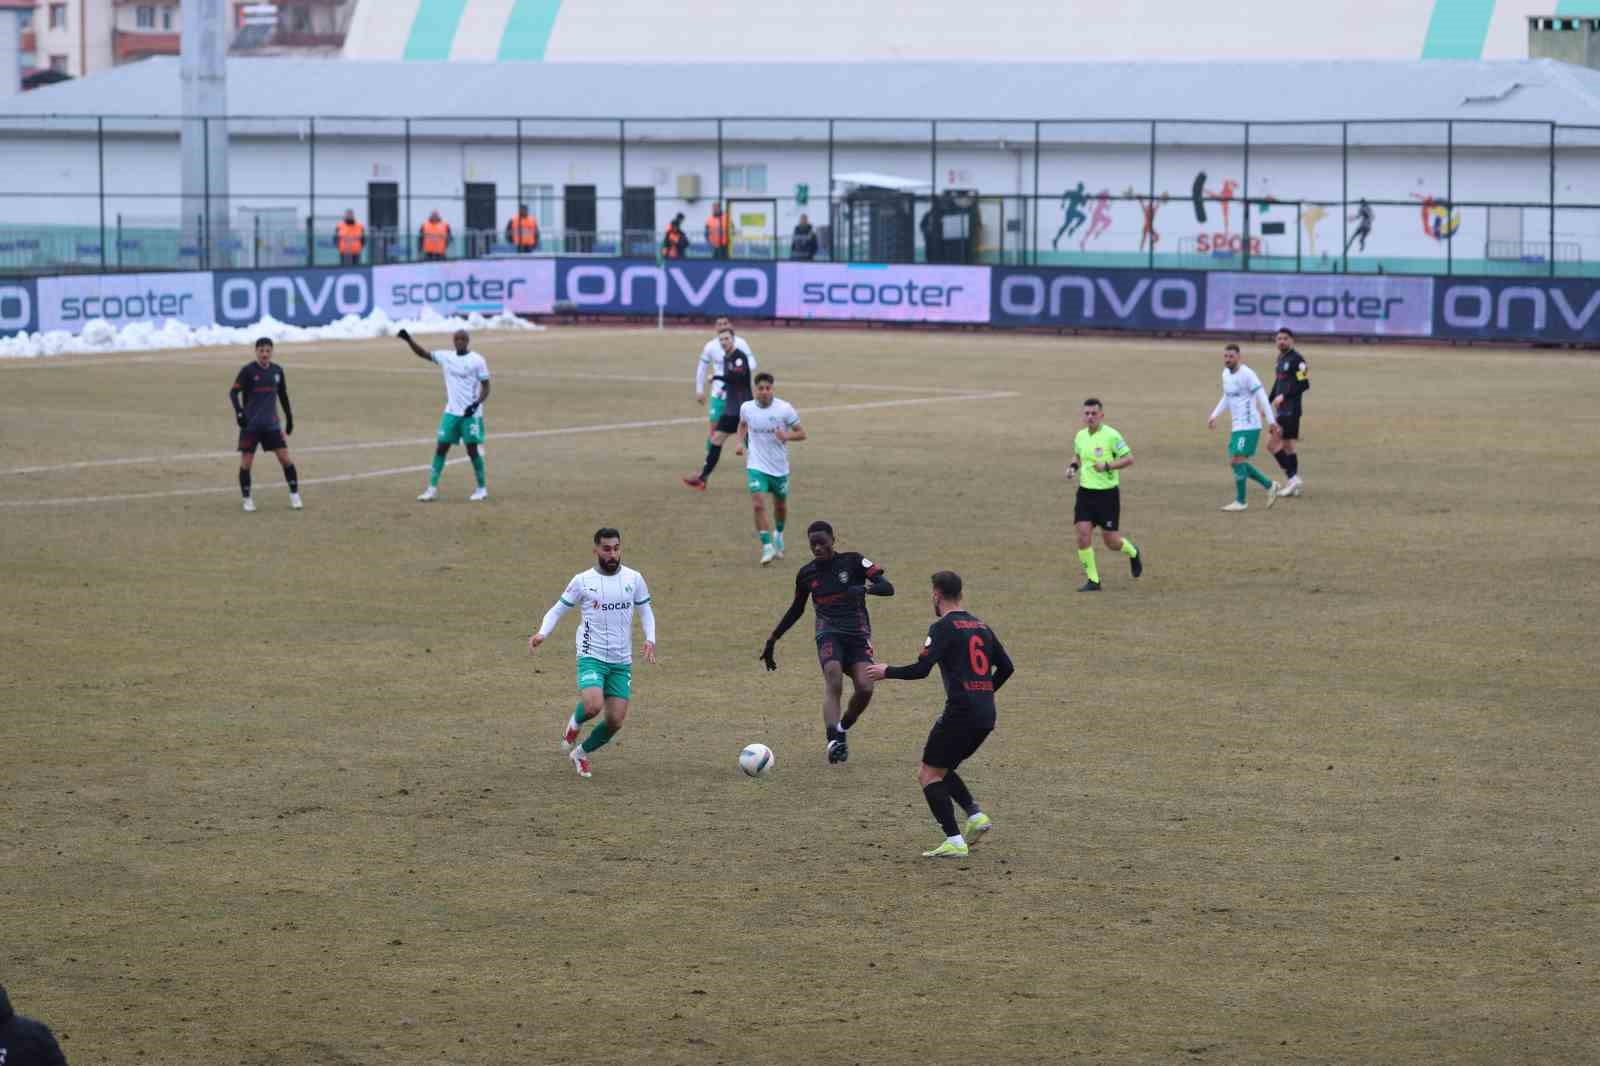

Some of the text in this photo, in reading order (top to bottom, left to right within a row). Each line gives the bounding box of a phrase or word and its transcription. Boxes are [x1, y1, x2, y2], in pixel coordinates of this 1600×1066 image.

[61, 290, 193, 320] scooter
[391, 275, 526, 305] scooter
[803, 279, 963, 307] scooter
[1234, 290, 1404, 319] scooter
[969, 635, 989, 676] 6
